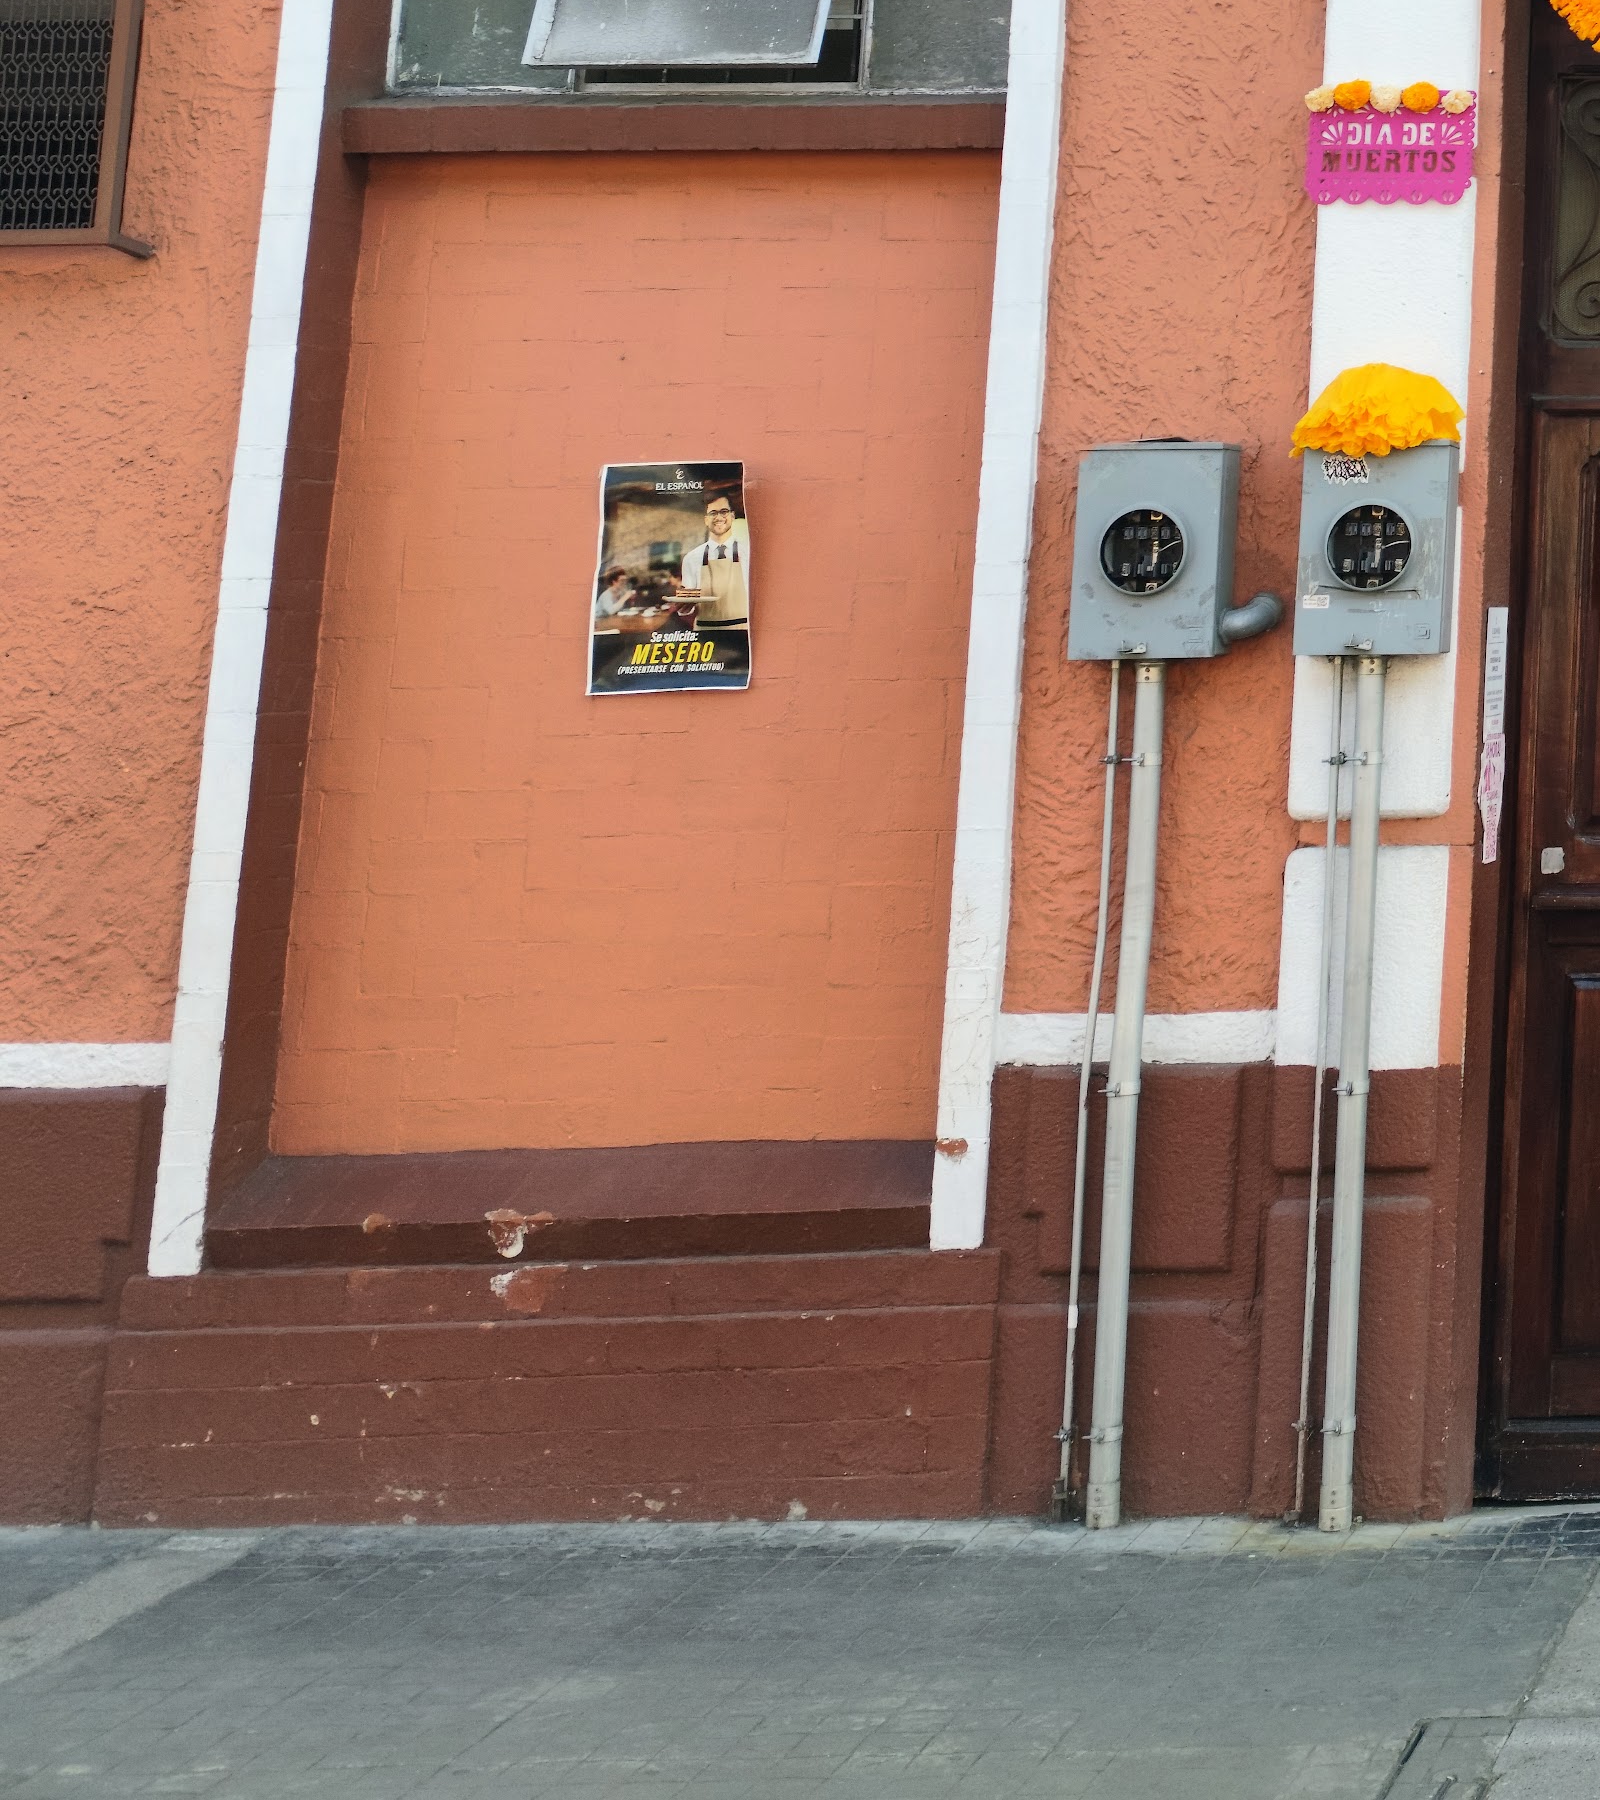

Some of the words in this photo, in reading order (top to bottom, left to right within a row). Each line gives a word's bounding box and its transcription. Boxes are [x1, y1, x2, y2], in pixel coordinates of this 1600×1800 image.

[1402, 122, 1436, 146] DE
[1320, 150, 1457, 173] MUERTOS
[655, 482, 666, 491] EL
[667, 480, 705, 491] ESPAÑOL
[650, 631, 662, 643] Se
[663, 630, 699, 642] solicita:
[631, 641, 715, 665] MESERO
[617, 664, 668, 675] (PRESENTARSE
[670, 664, 684, 673] CON
[686, 662, 725, 672] SOLICITUD)
